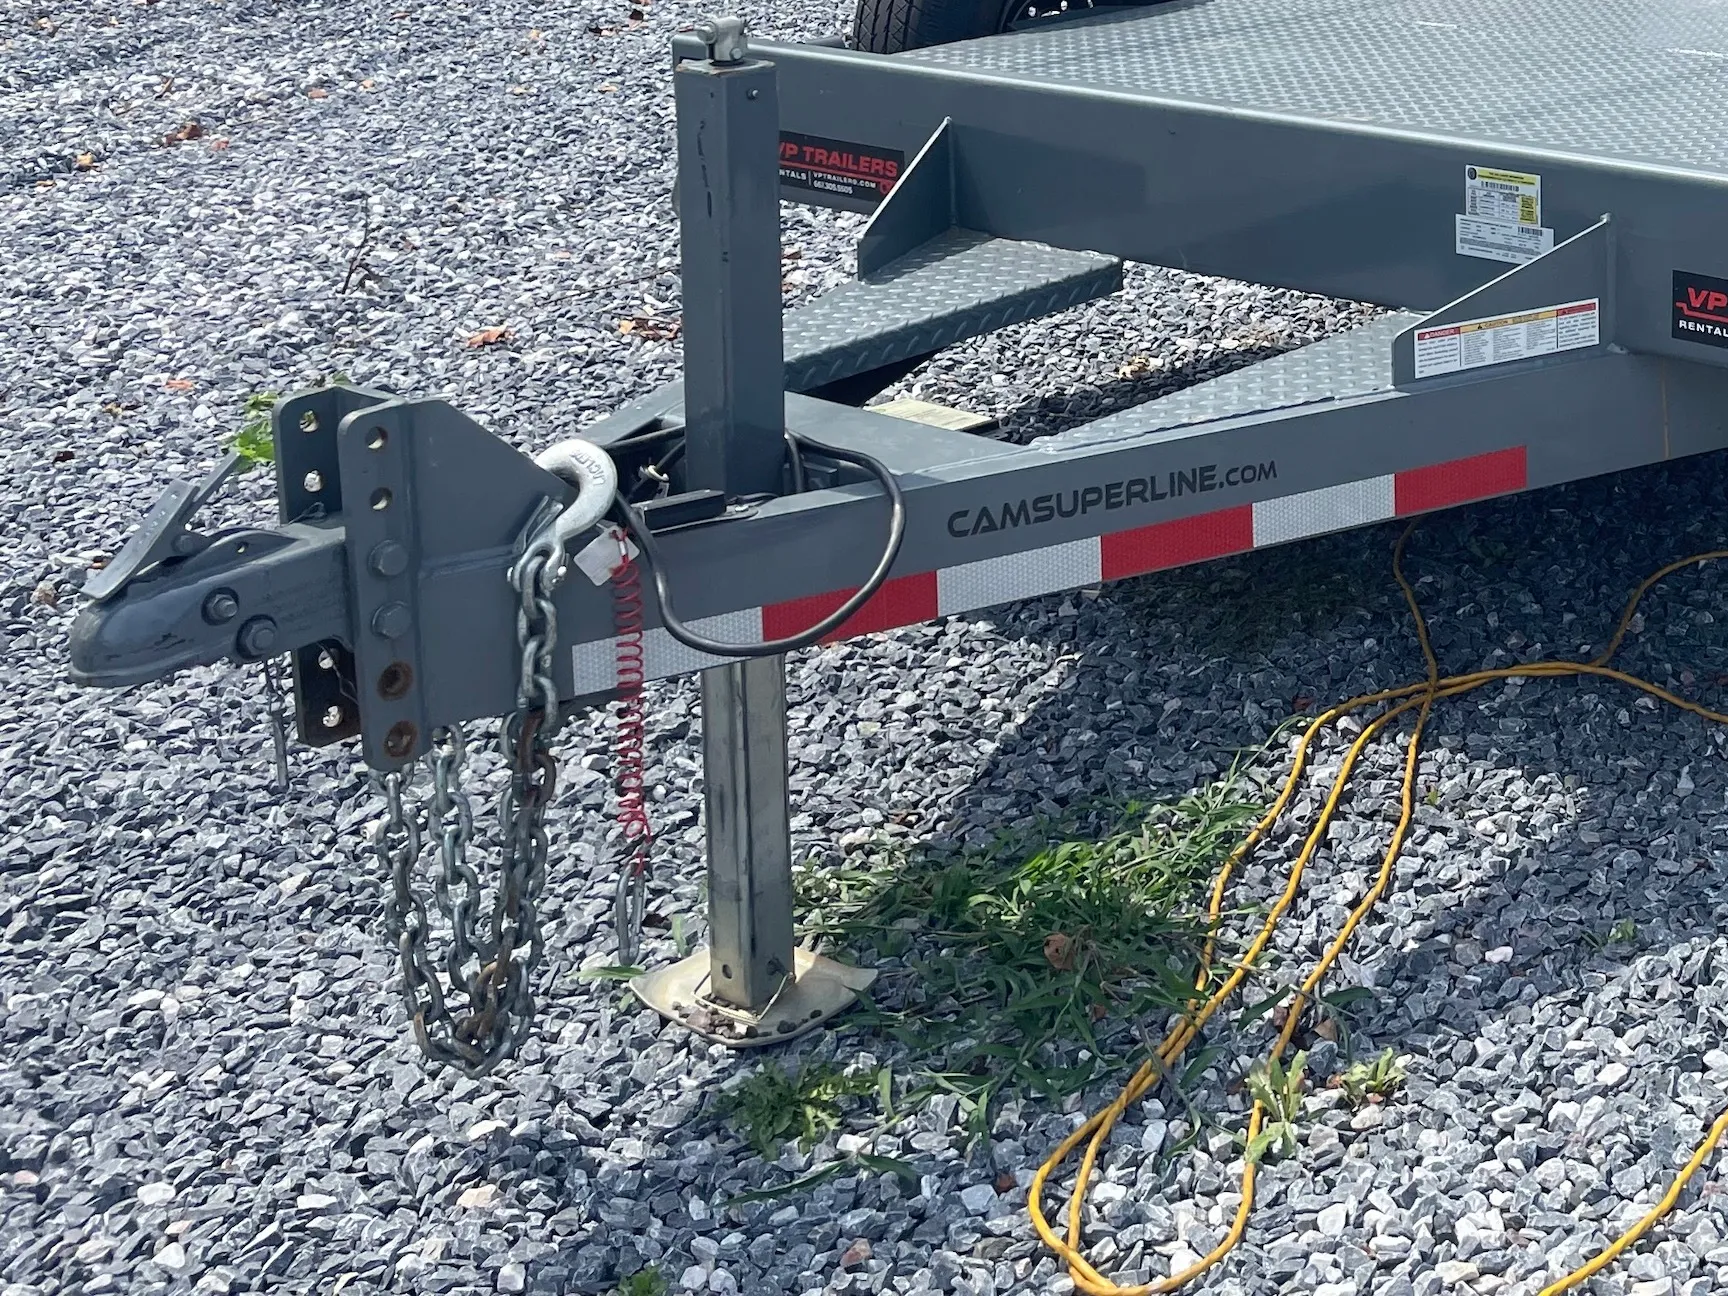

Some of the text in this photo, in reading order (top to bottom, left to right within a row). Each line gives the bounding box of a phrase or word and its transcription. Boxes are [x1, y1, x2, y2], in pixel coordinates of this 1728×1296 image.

[779, 169, 807, 181] NTALS
[803, 146, 898, 177] TRAILERS
[947, 460, 1278, 538] CAMSUPERLINE.COM
